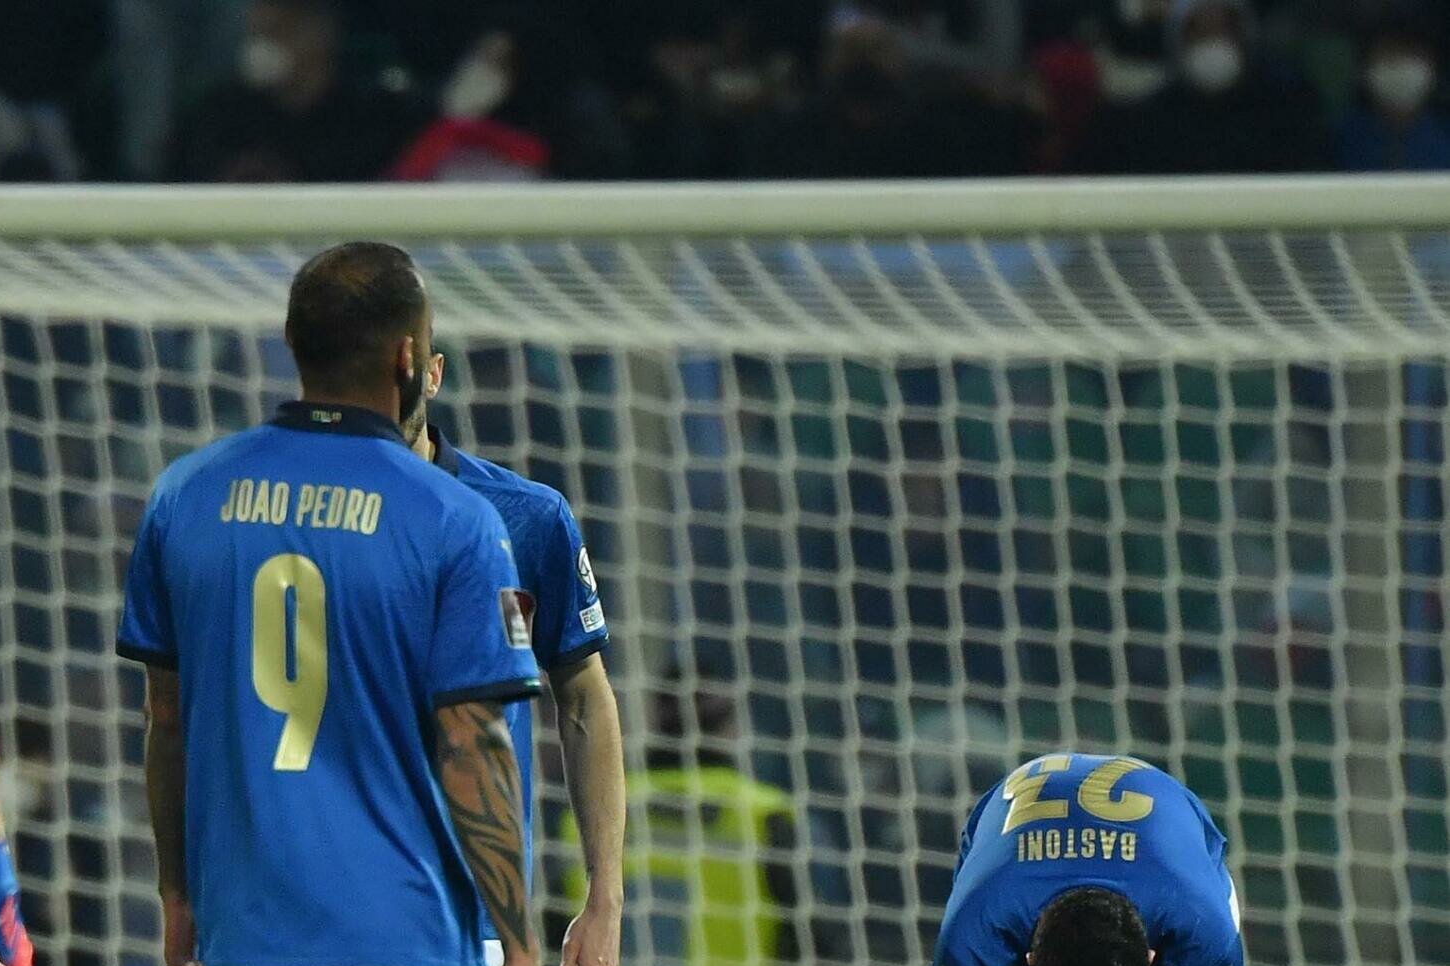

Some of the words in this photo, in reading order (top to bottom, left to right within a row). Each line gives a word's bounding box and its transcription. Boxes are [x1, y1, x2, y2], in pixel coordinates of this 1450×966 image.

[221, 478, 290, 526] JOAO
[295, 484, 382, 536] PEDRO
[253, 553, 328, 770] 9
[1002, 755, 1154, 836] 23
[1017, 828, 1136, 862] BASTONI
